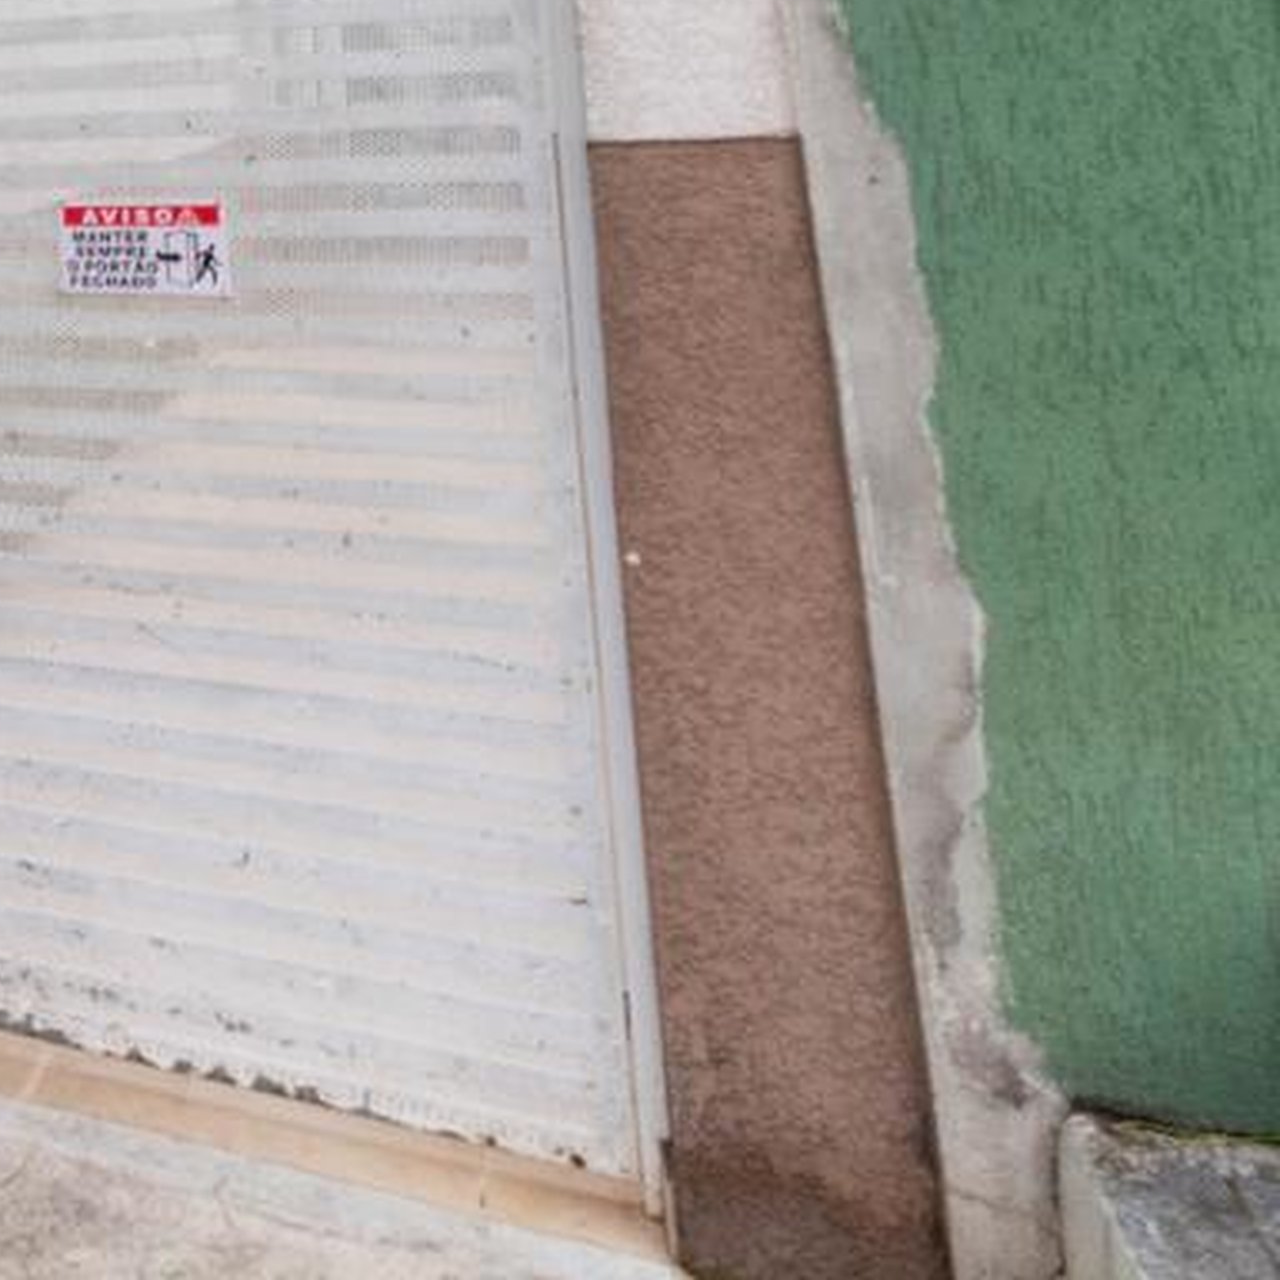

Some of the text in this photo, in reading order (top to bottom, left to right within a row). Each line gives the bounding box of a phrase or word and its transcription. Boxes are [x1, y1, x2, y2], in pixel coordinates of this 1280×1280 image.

[82, 208, 174, 226] AVISO
[72, 231, 148, 243] MANTER
[76, 246, 147, 258] SEMPRE
[70, 276, 158, 289] FECHADO
